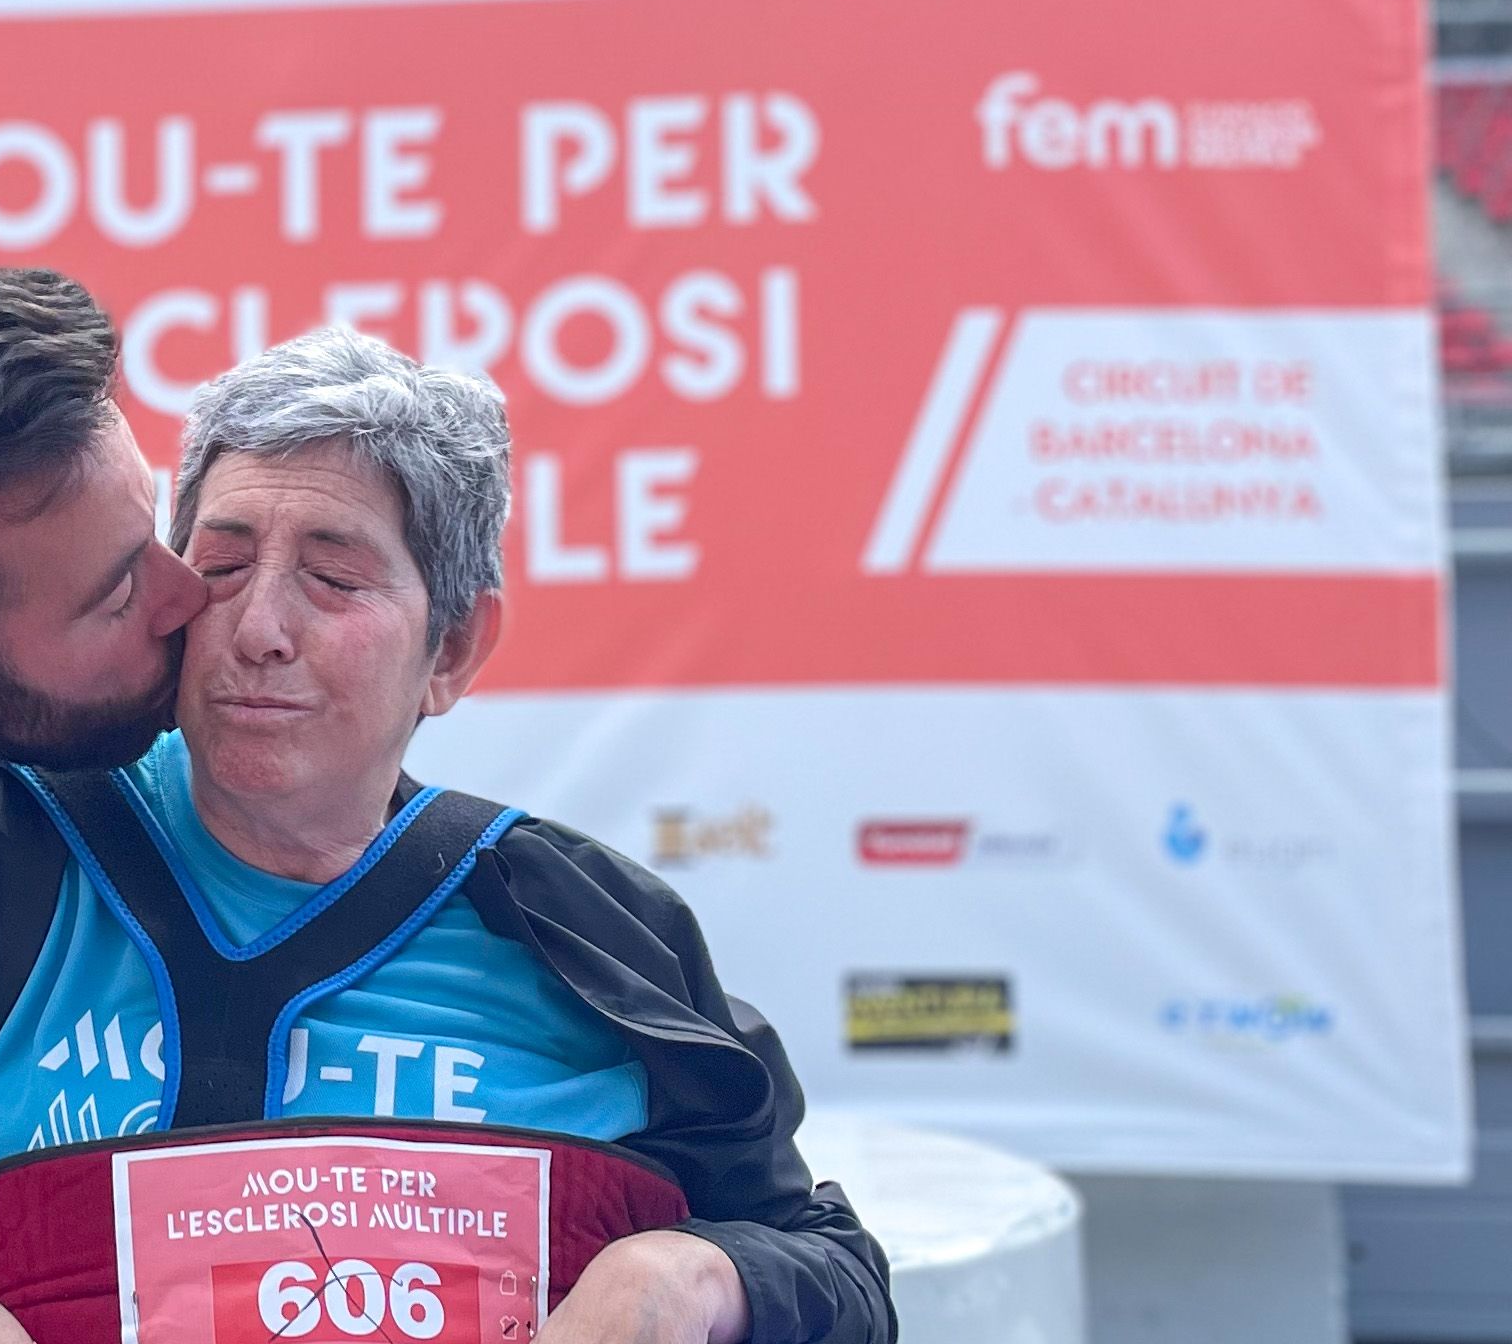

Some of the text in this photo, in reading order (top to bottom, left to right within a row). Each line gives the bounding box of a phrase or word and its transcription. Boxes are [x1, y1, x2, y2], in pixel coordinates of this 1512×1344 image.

[978, 71, 1180, 170] fem
[520, 92, 820, 234] PER
[1062, 358, 1316, 402] CIRCUIT DE
[1028, 420, 1320, 466] BARCELONA
[242, 1167, 437, 1198] MOU-TE PER
[167, 1200, 508, 1240] L'ESCLEROSI MÚLTIPLE
[257, 1259, 445, 1340] 606
